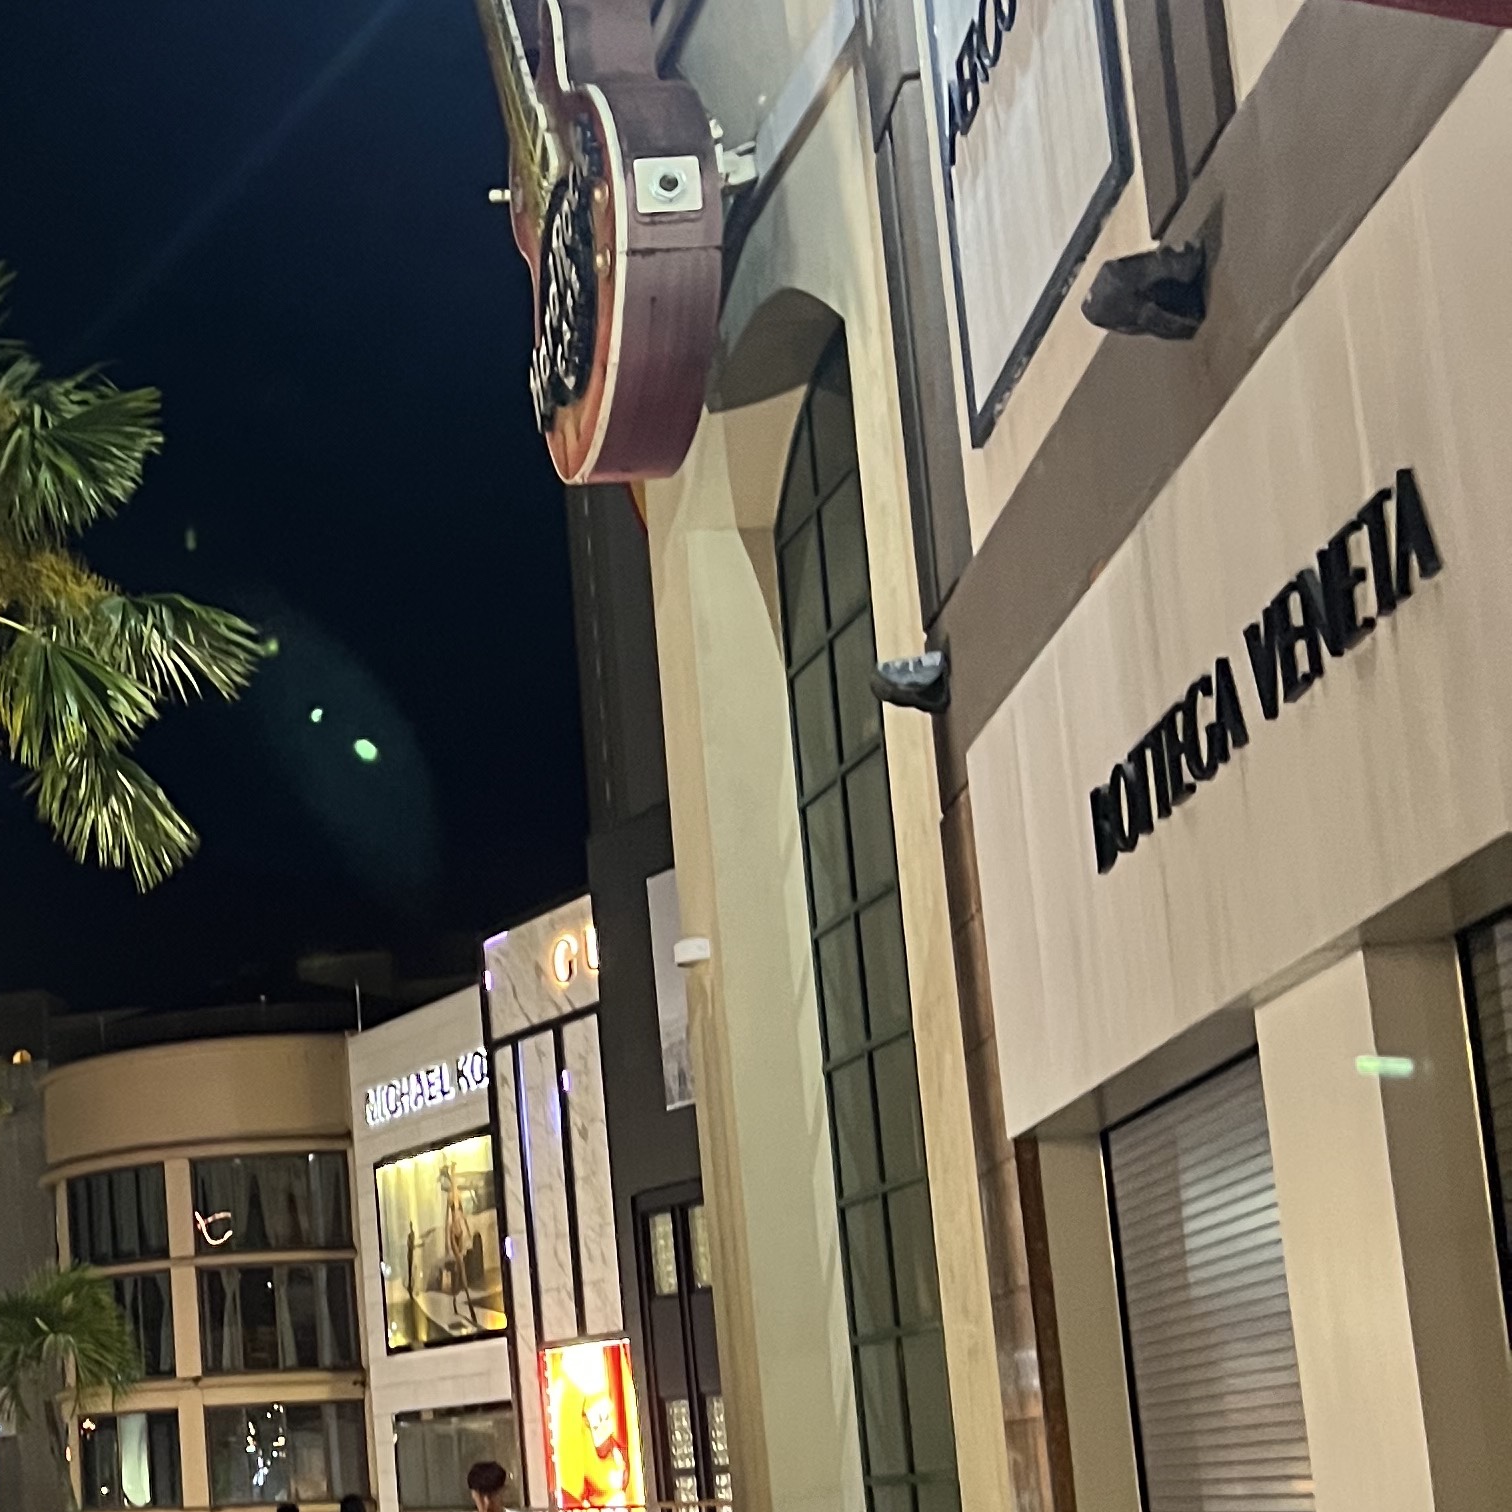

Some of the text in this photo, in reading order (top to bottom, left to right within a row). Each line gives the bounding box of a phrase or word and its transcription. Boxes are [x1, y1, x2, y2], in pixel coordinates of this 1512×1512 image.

[1090, 468, 1443, 875] BOTTEGA VENETA
[365, 1062, 456, 1126] MICHAEL
